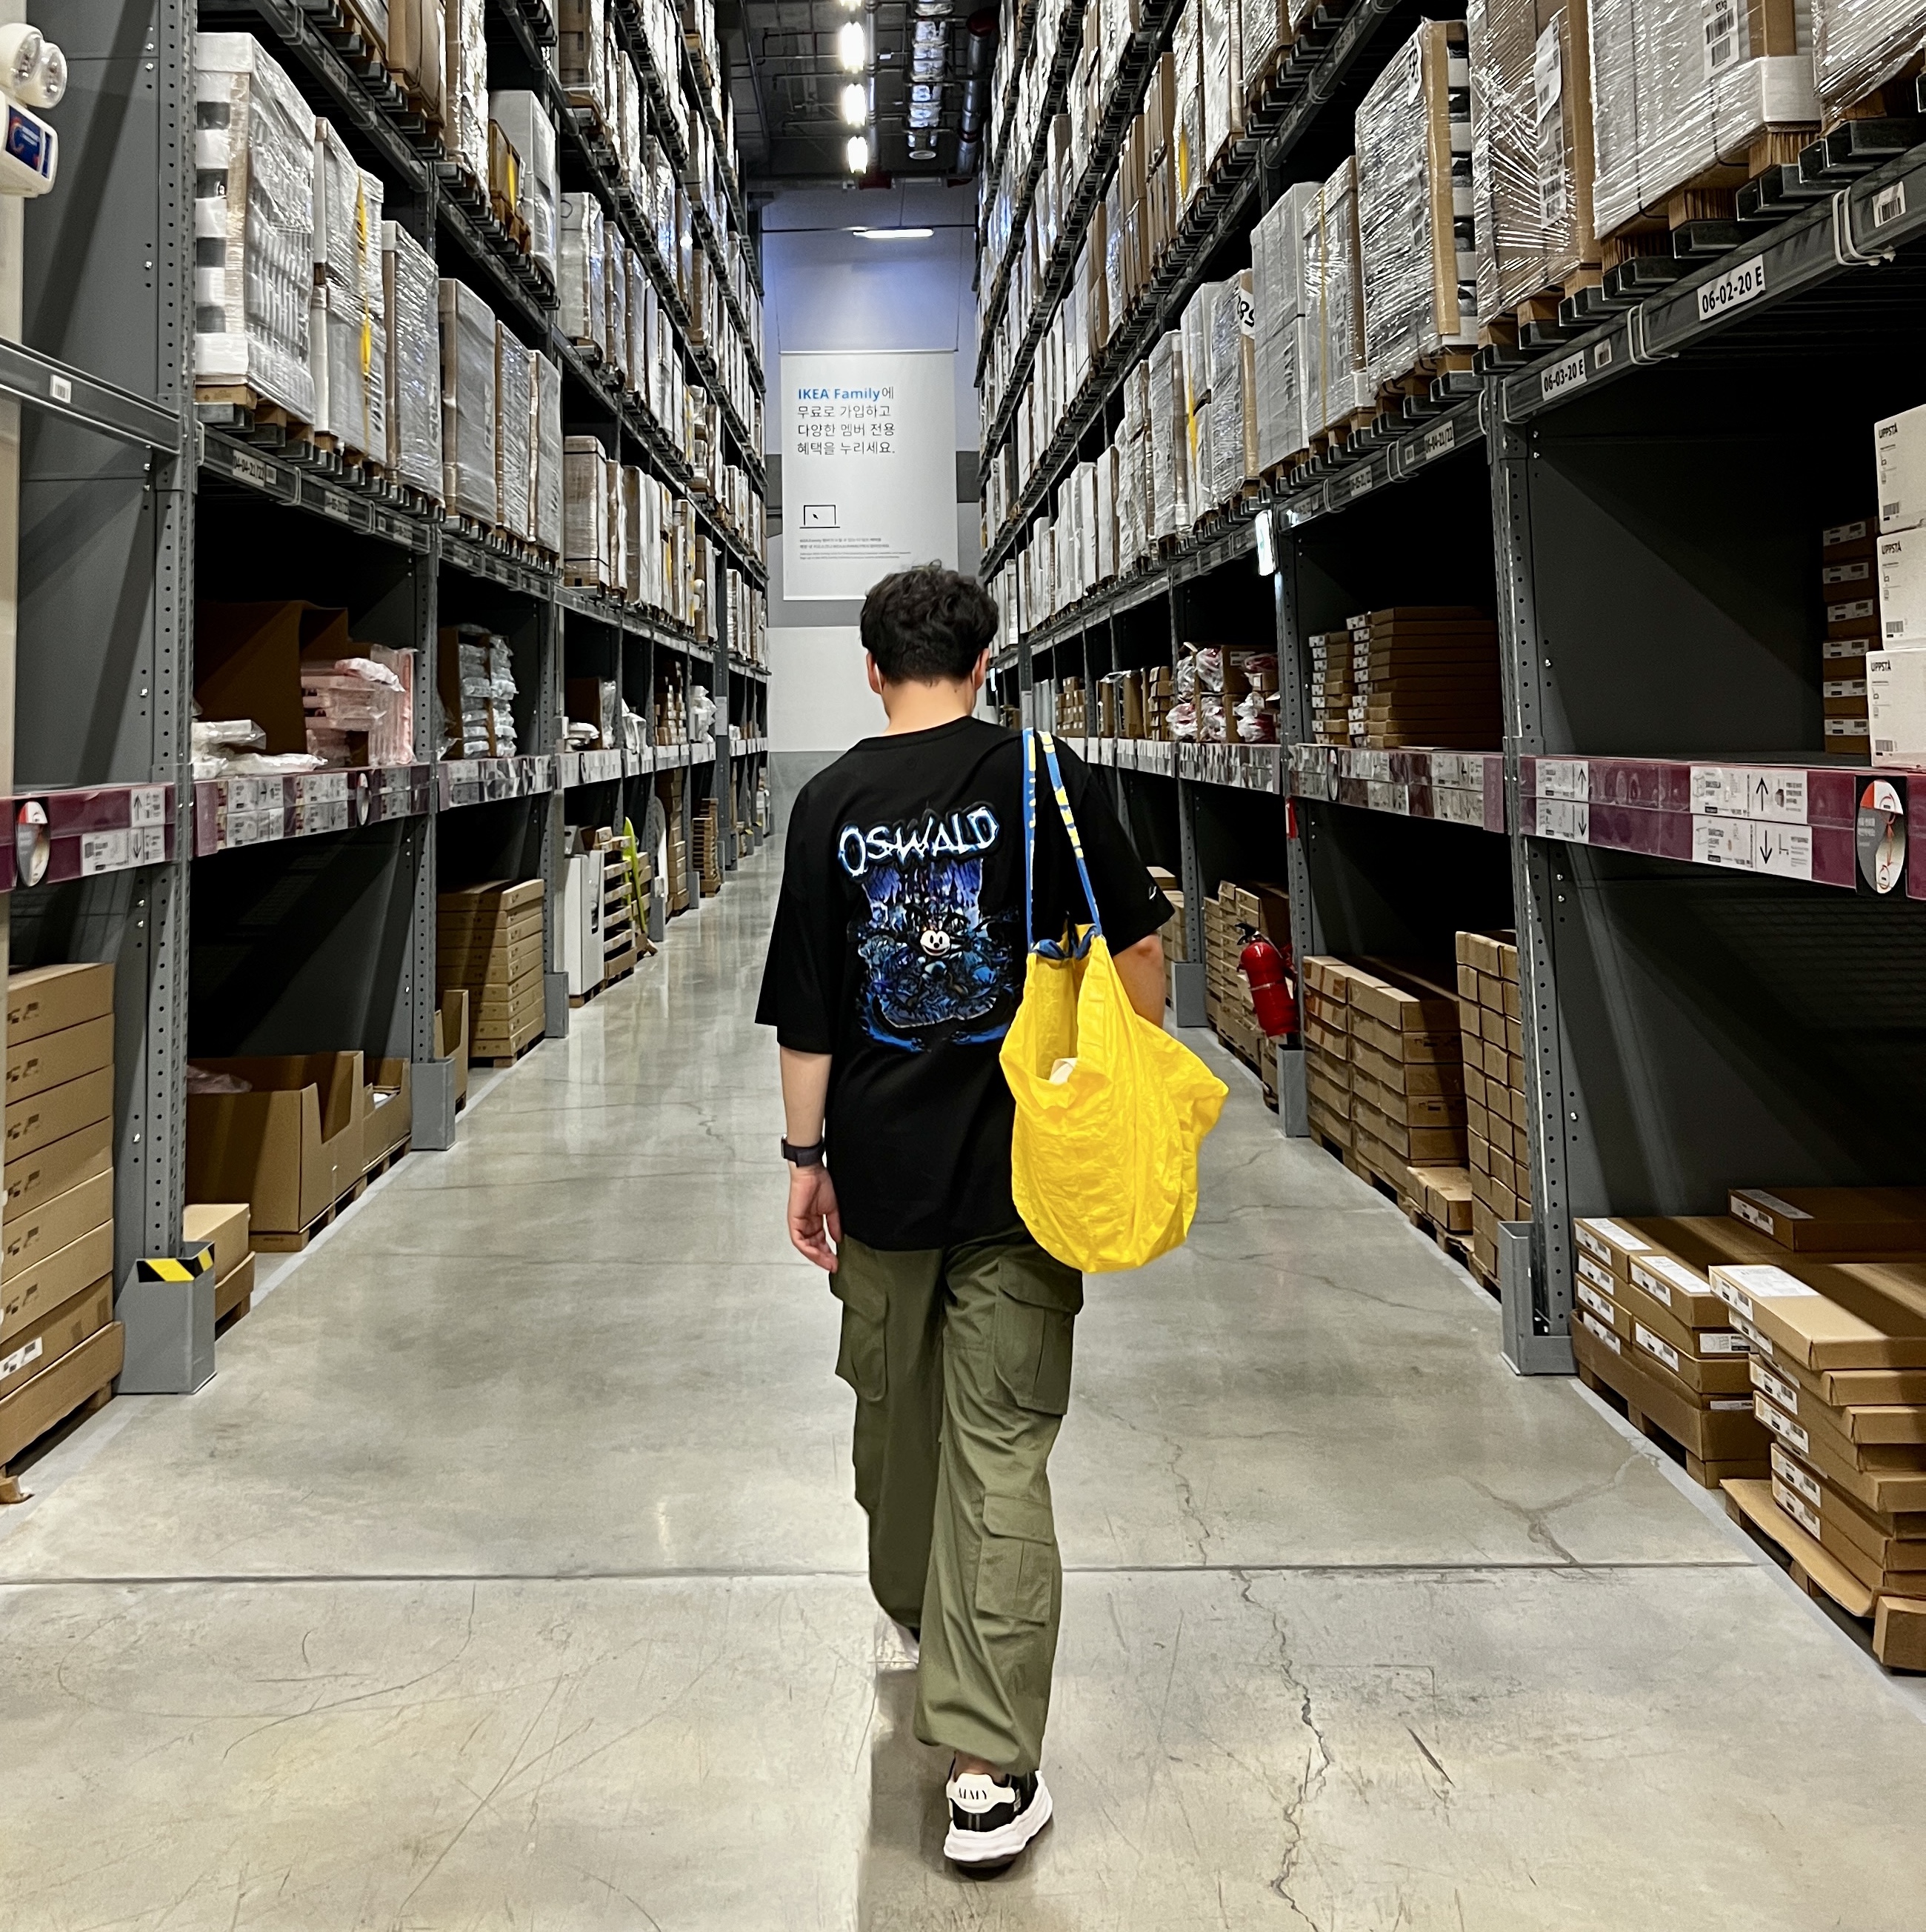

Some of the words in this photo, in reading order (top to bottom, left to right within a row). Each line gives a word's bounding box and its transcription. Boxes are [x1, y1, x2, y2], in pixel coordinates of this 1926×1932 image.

[1702, 271, 1752, 313] 06-02-20
[1755, 266, 1762, 287] E
[1544, 362, 1577, 393] 06-03-20
[1579, 359, 1584, 376] E
[798, 387, 830, 401] IKEA
[834, 386, 895, 402] Family에
[798, 405, 836, 419] 무료로
[840, 405, 891, 419] 가입하고
[798, 423, 836, 437] 다양한
[840, 423, 866, 437] 멤버
[870, 422, 896, 436] 전용
[797, 442, 835, 456] 혜택을
[840, 441, 896, 456] 누리세요.
[839, 806, 999, 877] OSWALD
